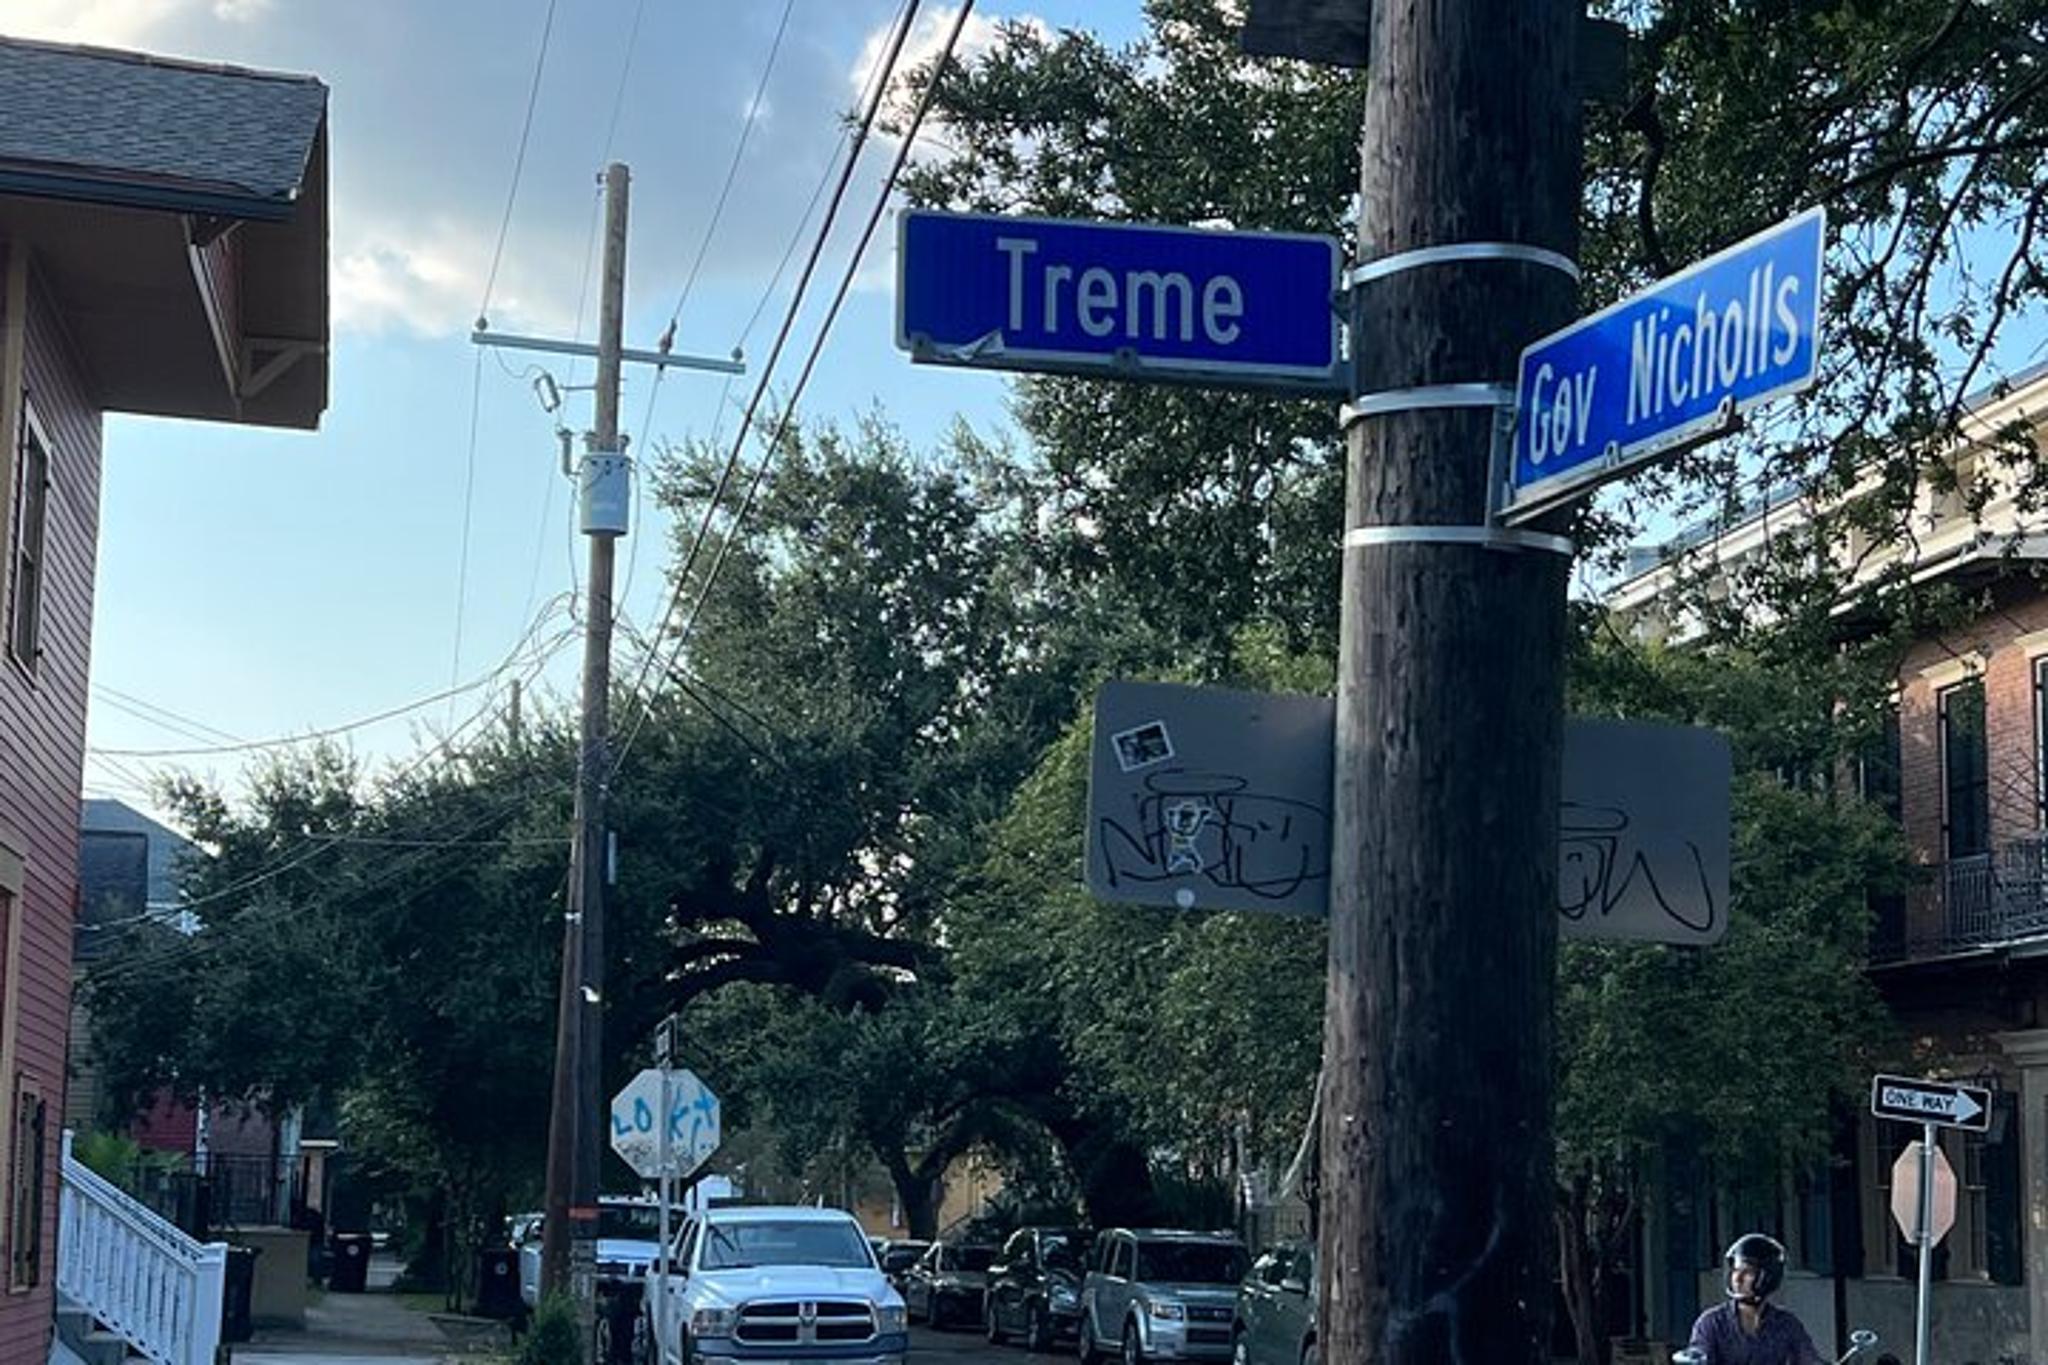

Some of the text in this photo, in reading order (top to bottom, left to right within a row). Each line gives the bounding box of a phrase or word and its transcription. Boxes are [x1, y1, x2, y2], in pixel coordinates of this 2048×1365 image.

[997, 237, 1245, 345] Treme
[1528, 260, 1800, 466] Gov Nicholls
[1886, 1089, 1954, 1110] ONE WAY
